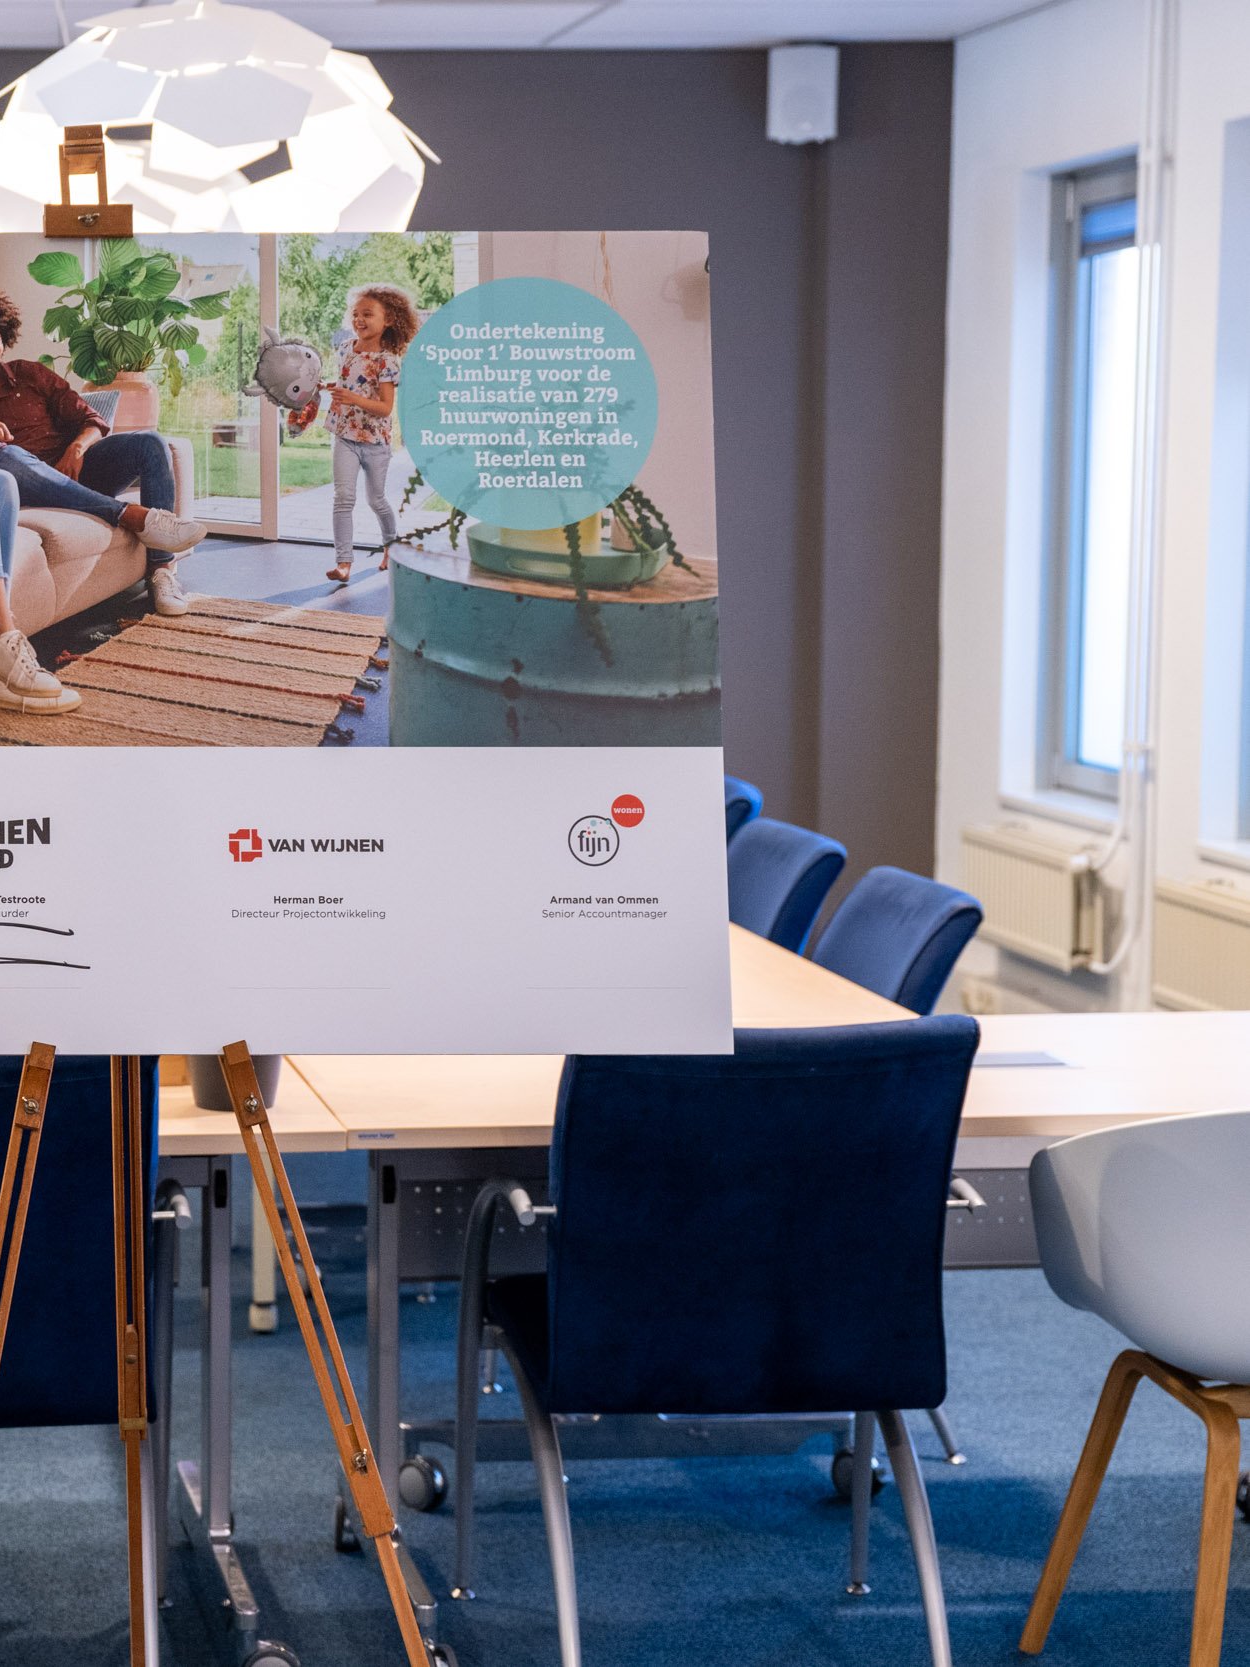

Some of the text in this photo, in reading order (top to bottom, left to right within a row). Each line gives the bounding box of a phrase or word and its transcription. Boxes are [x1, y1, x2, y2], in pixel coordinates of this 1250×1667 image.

[450, 323, 605, 344] Ondertekening
[509, 345, 636, 361] Bouwstroom
[445, 366, 611, 386] Limburg voor de
[438, 386, 618, 403] realisatie van 279
[440, 408, 618, 428] huurwoningen in
[421, 429, 638, 448] Roermond, Kerkrade,
[474, 450, 586, 467] Heerlen en
[478, 471, 583, 488] Roerdalen
[613, 806, 643, 815] wonen
[268, 839, 384, 852] VAN WIJNEN
[578, 830, 610, 857] fijn
[273, 895, 344, 904] Herman Boer
[549, 895, 592, 904] Armand
[617, 895, 659, 904] Ommen
[231, 909, 386, 920] Directeur Projectontwikkeling
[541, 909, 668, 920] Senior Accountmanager
